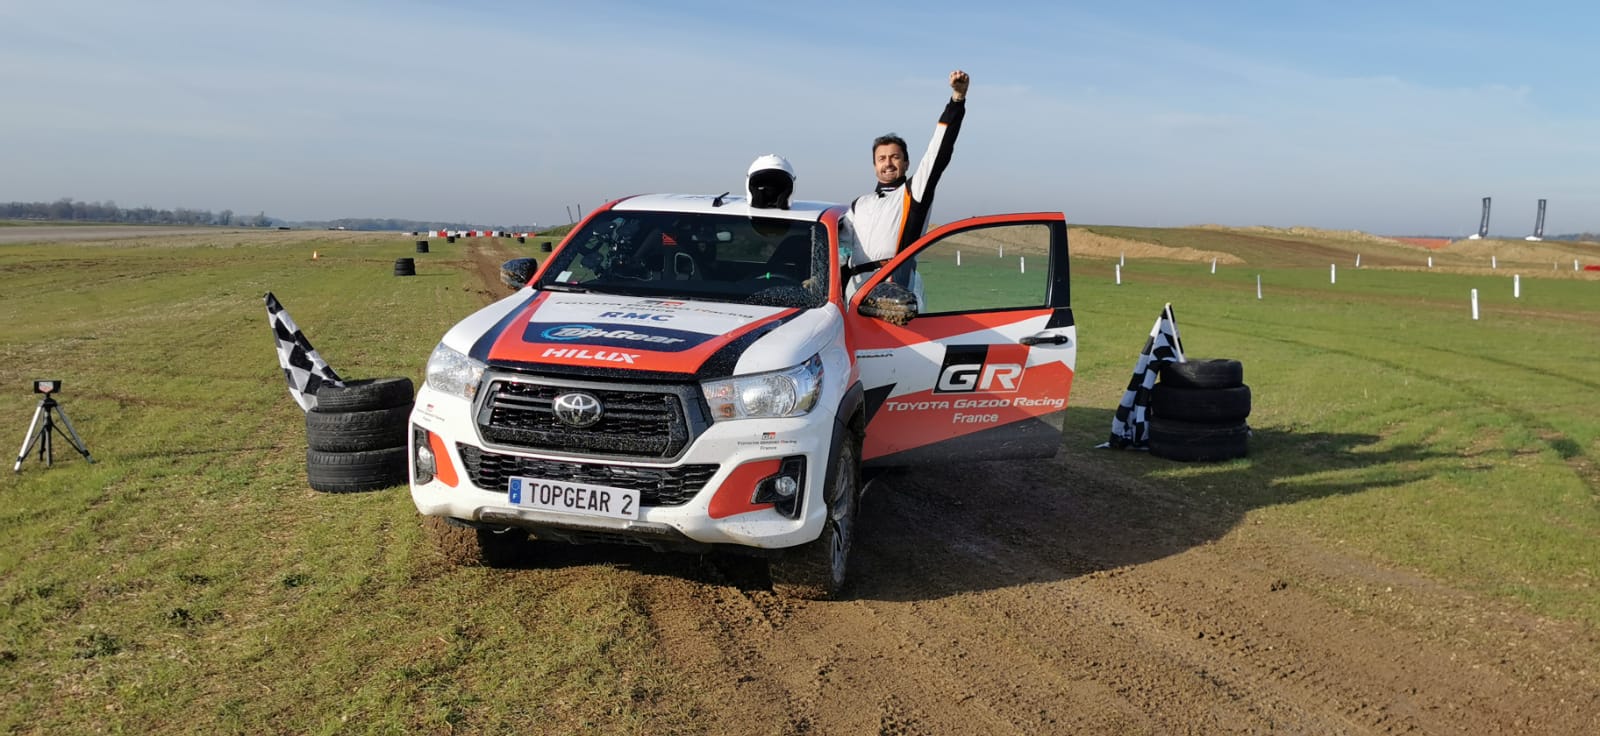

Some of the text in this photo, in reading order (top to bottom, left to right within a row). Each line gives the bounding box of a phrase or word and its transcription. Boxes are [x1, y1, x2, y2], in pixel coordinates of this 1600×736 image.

[599, 311, 677, 322] RMC
[541, 348, 640, 364] HILUX
[938, 363, 1022, 391] GR
[886, 397, 1065, 412] TOYOTA GAZOO Racing
[952, 412, 998, 424] France
[528, 482, 633, 515] TOPGEAR 2
